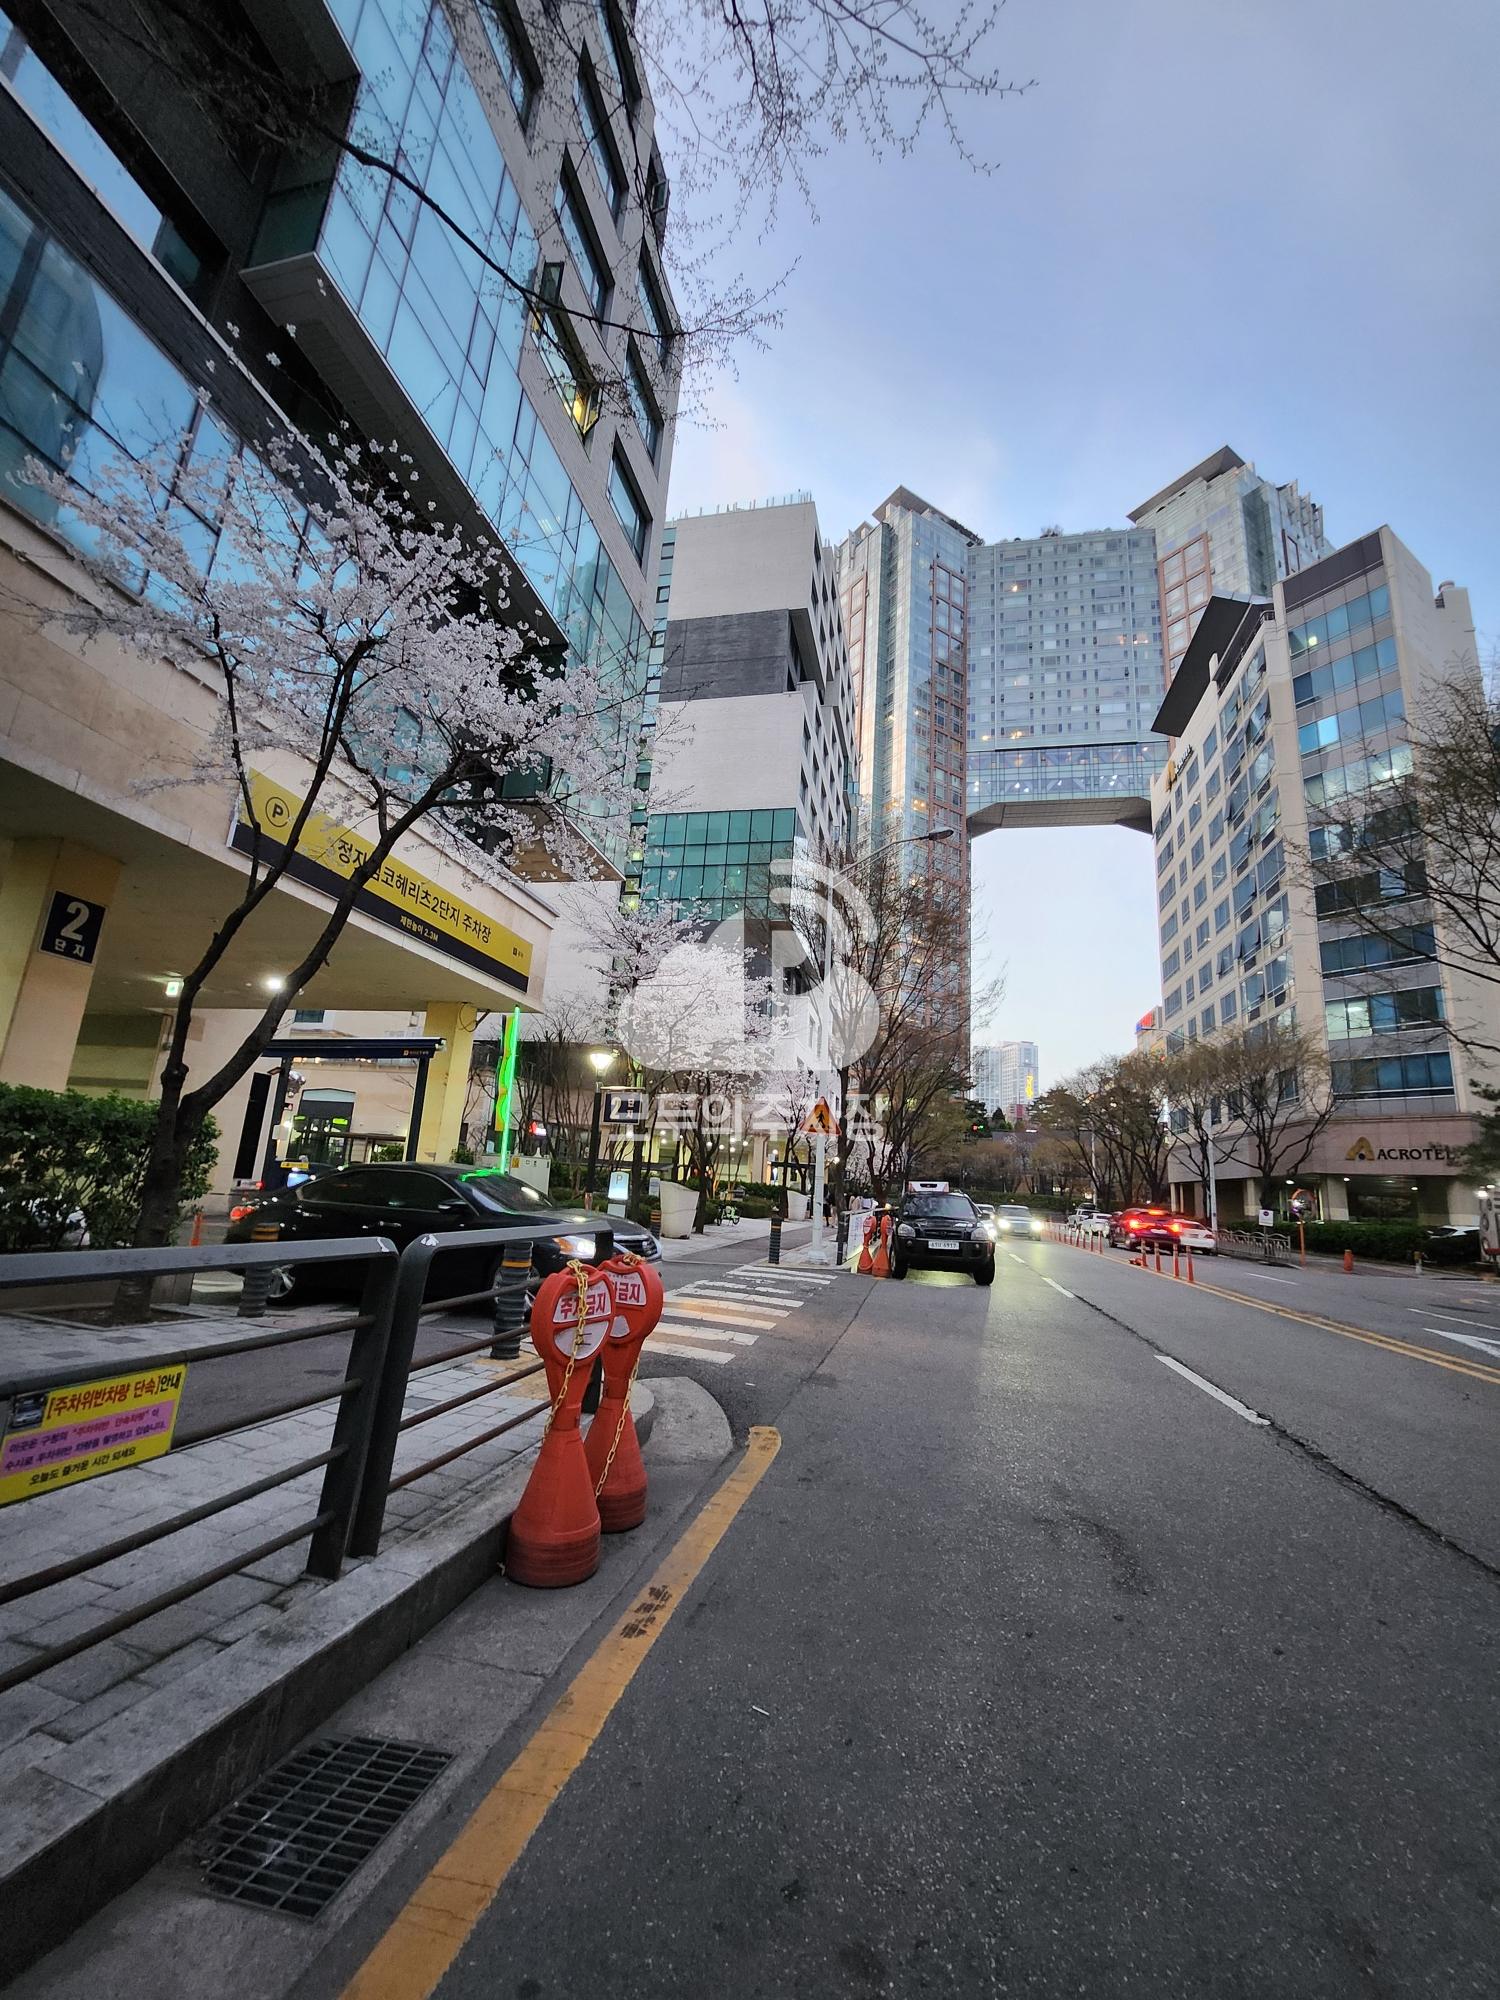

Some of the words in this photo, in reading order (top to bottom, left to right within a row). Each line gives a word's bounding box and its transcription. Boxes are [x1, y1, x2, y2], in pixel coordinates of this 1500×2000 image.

[60, 901, 90, 941] 2
[462, 912, 492, 944] 주차장
[55, 939, 85, 957] 단지
[610, 1096, 622, 1119] 2
[1377, 1148, 1456, 1160] ACROTEL
[615, 1174, 624, 1185] P
